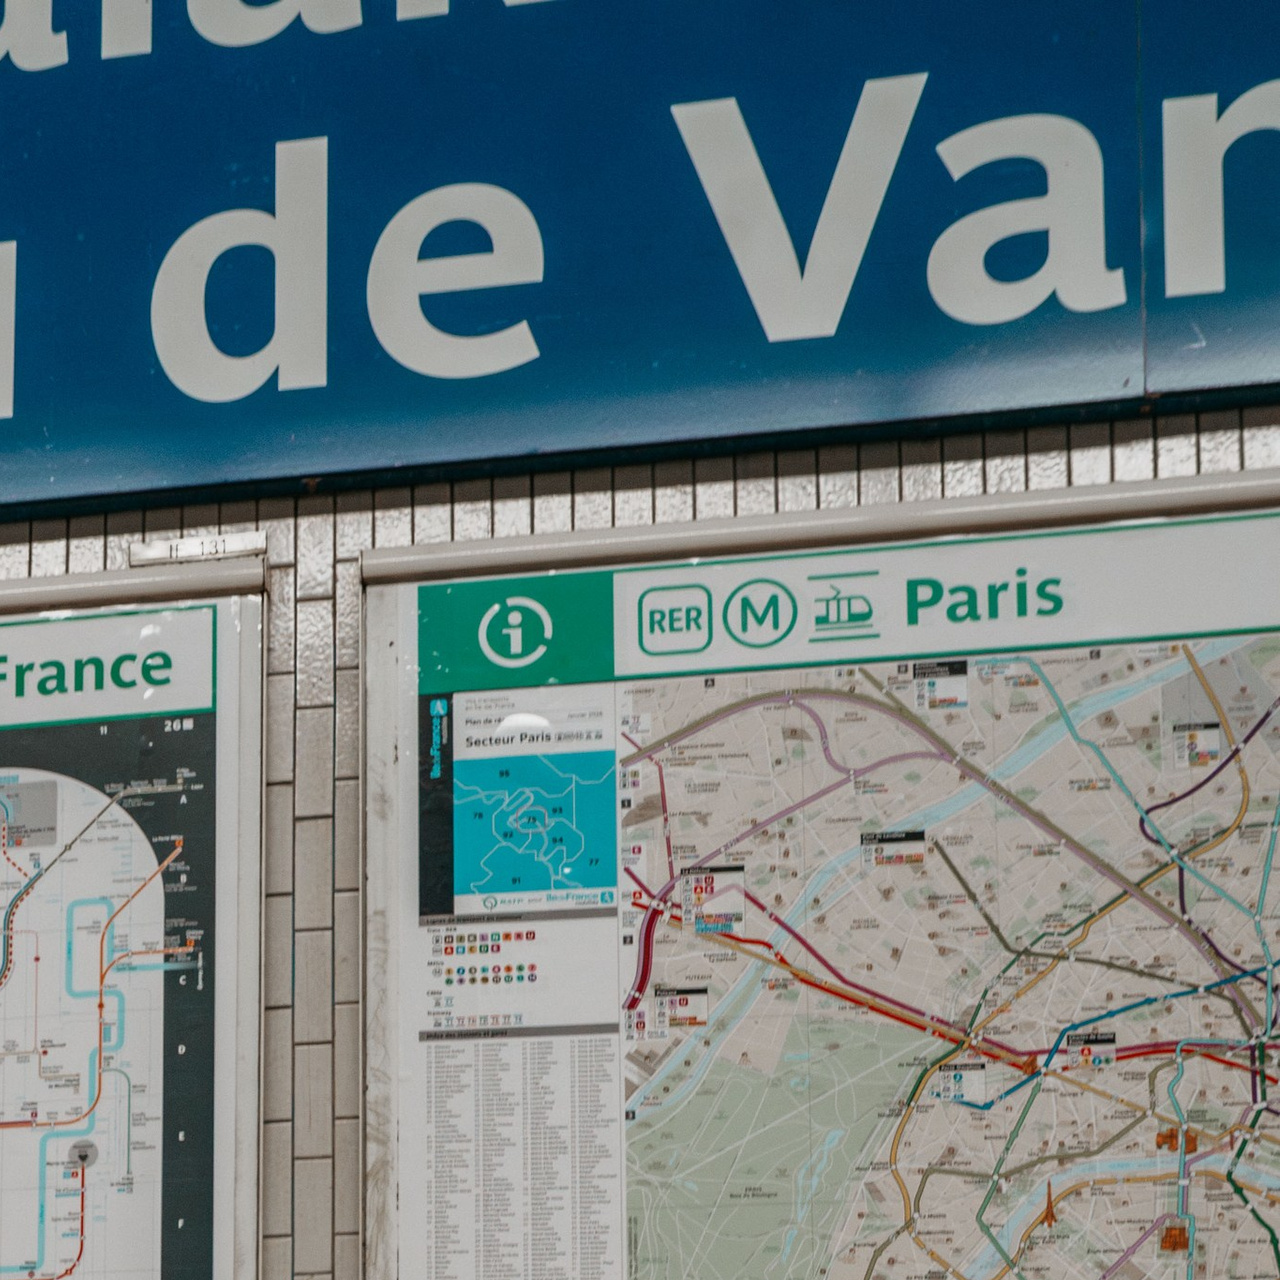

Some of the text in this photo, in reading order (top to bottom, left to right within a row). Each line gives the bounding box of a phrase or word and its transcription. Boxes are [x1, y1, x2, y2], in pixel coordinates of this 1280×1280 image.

[151, 136, 544, 403] de
[671, 73, 1280, 343] Van
[740, 592, 781, 634] M
[905, 566, 1064, 627] Paris
[648, 605, 703, 636] RER
[465, 731, 552, 748] Secteur Paris
